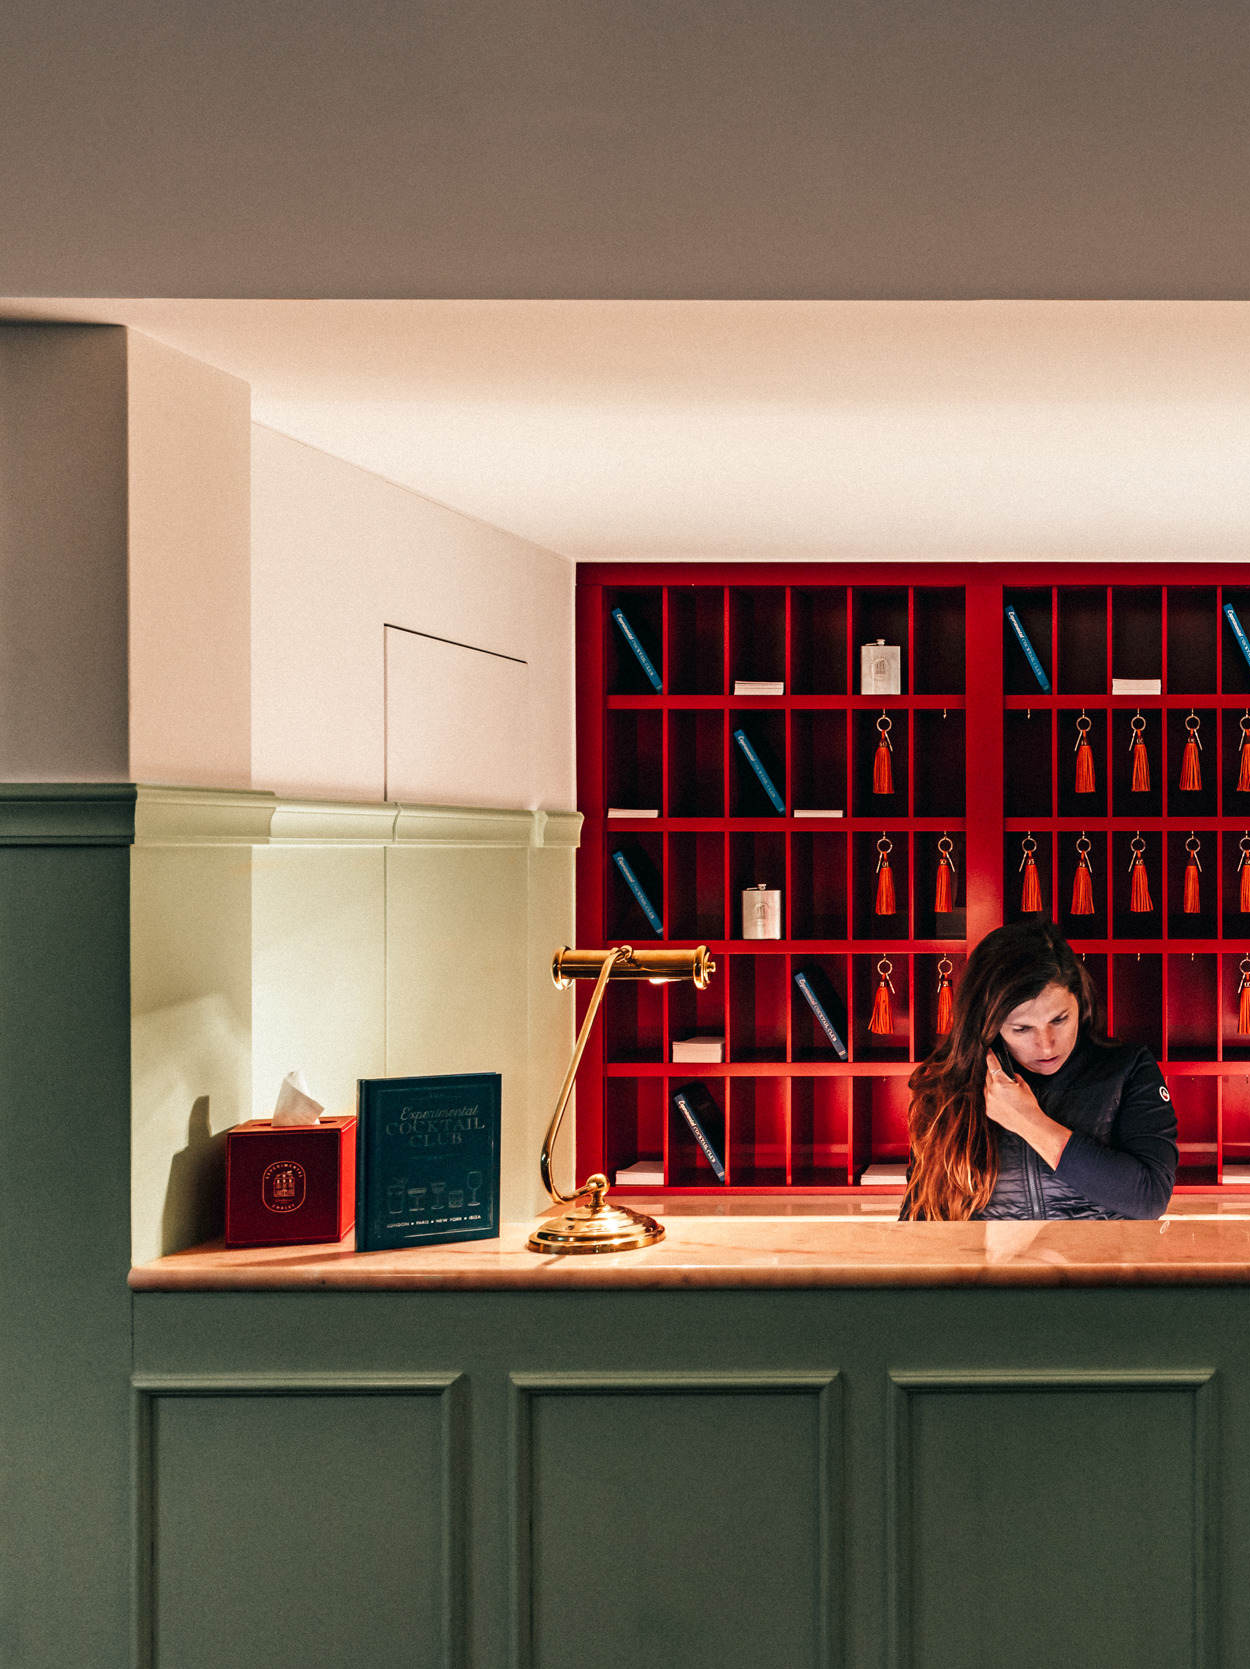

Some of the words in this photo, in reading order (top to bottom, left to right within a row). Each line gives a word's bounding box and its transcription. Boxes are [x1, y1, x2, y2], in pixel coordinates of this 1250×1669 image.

[400, 1104, 478, 1121] Experimental
[386, 1118, 485, 1135] COCKTAIL
[410, 1132, 462, 1148] CLUB
